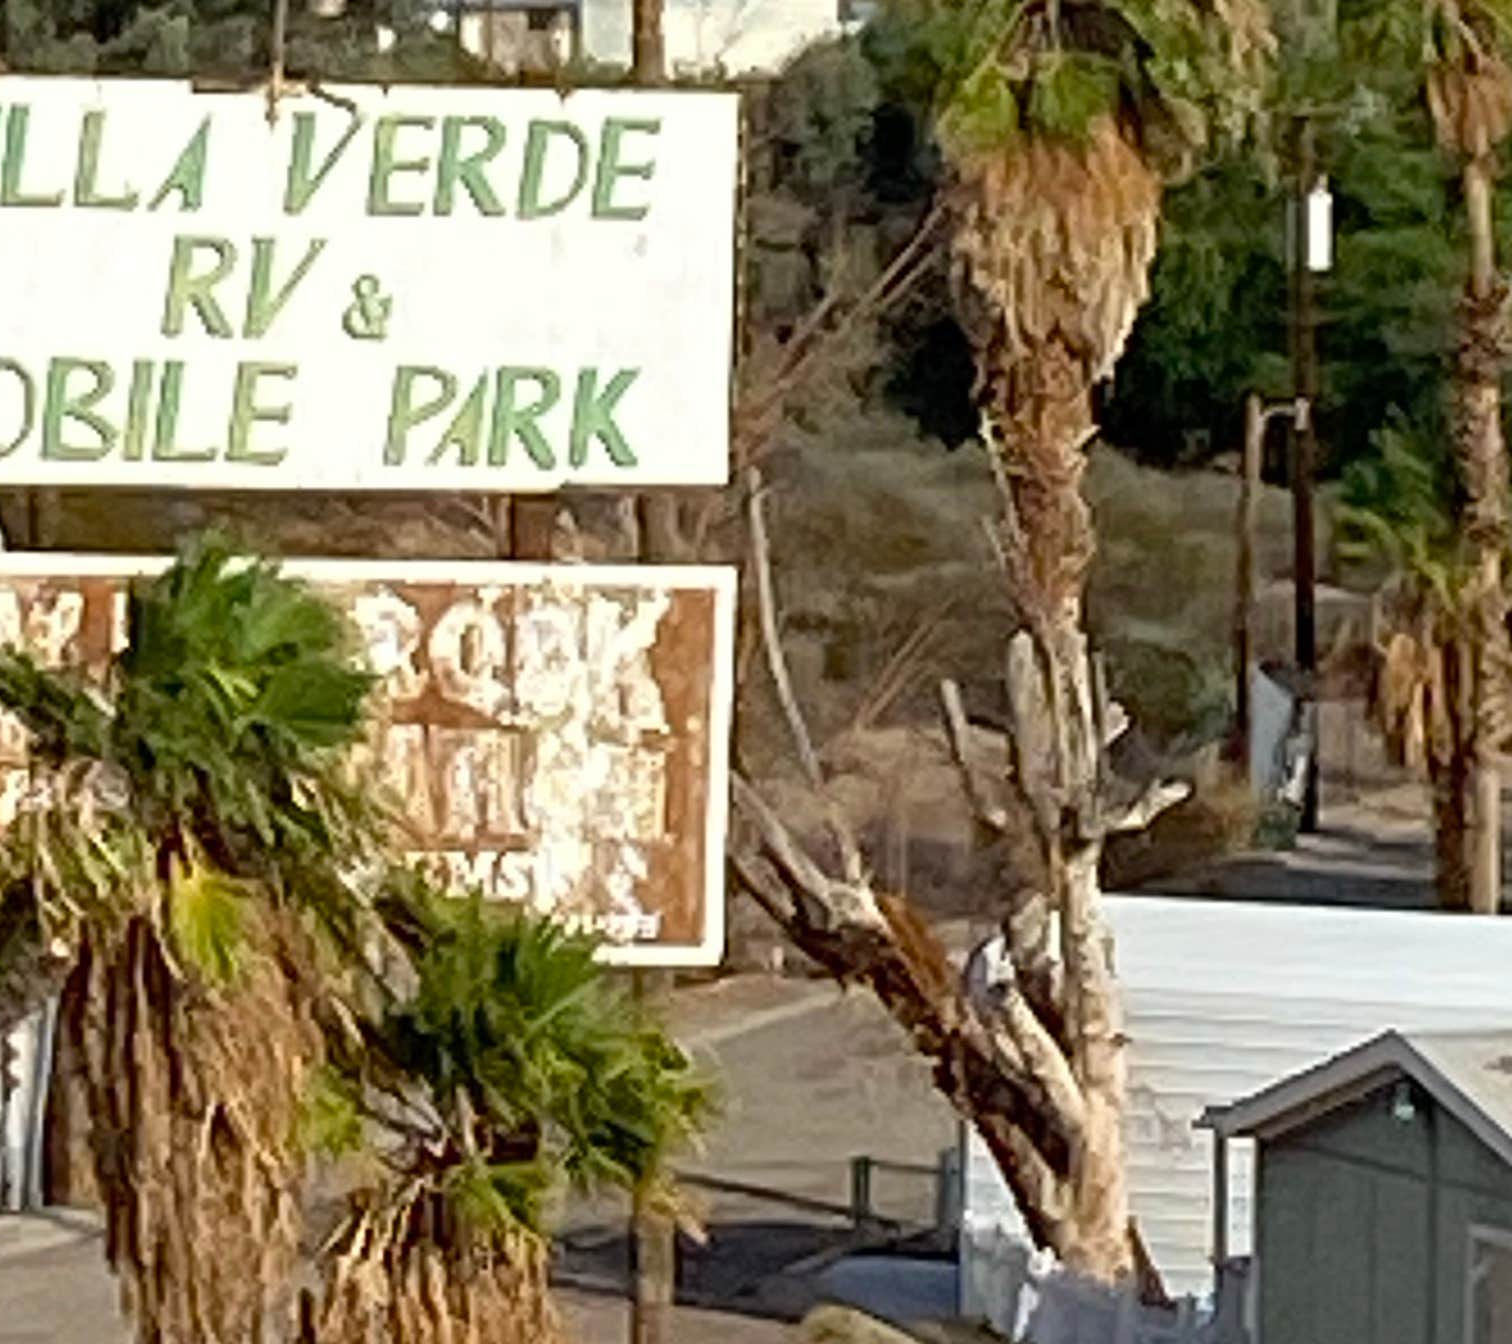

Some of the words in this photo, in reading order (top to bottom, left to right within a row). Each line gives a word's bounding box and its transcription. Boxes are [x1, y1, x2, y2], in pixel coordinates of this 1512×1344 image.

[283, 111, 662, 220] VERDE
[160, 234, 328, 340] RV
[341, 273, 393, 341] &
[381, 364, 641, 469] PARK
